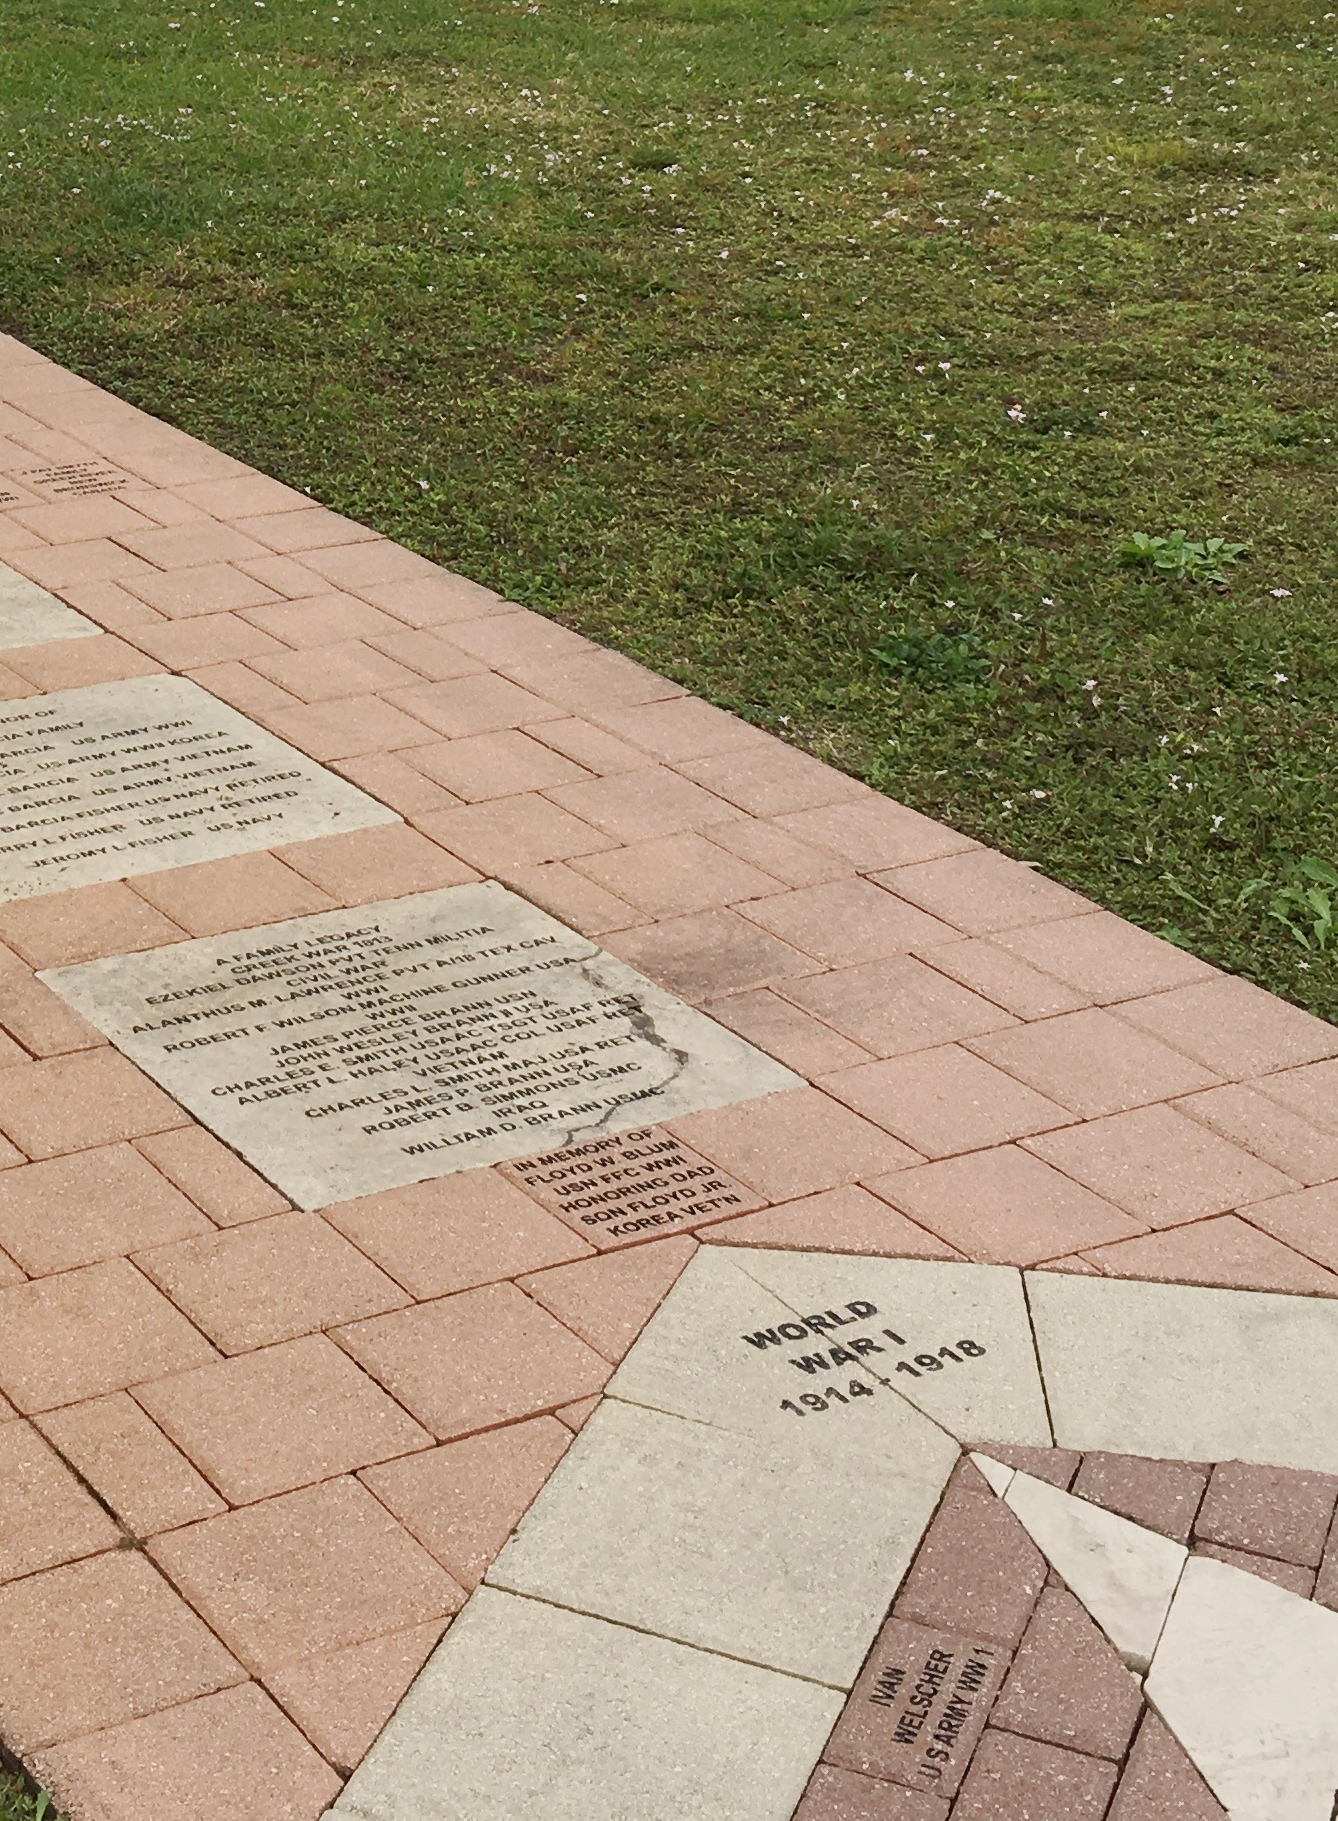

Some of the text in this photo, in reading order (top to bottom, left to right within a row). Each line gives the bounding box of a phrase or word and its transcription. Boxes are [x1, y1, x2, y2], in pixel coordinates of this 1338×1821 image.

[25, 720, 84, 737] FAMILY
[34, 709, 56, 718] OF
[36, 761, 63, 770] US
[67, 750, 117, 765] ARMY
[166, 730, 228, 746] KOREA
[111, 844, 127, 852] L
[127, 830, 196, 848] FISHER
[206, 822, 234, 832] US
[235, 812, 284, 827] NAVY
[144, 926, 495, 1005] EZEKIEL DAWSON PVT TENN MILITIA
[216, 924, 381, 967] A FAMILY LEGACY
[230, 954, 302, 974] CREEK
[300, 944, 351, 960] WAR
[285, 960, 389, 988] CIVIL WAR
[340, 984, 389, 1000] WWI
[162, 1027, 250, 1053] ROBERT
[271, 1004, 357, 1028] WILSON
[357, 984, 450, 1010] MACHINE
[450, 966, 534, 989] GUNNER
[534, 956, 581, 970] USA
[270, 990, 538, 1056] JAMES PIERCE BRANN USN
[364, 1004, 418, 1021] WWII
[275, 999, 559, 1068] JOHN WESLEY BRANN II USA
[411, 1050, 510, 1078] VIETNAM
[361, 1106, 452, 1135] ROBERT
[480, 1077, 581, 1106] SIMMONS
[578, 1062, 642, 1082] USMC
[383, 1092, 454, 1116] JAMES
[473, 1068, 552, 1093] BRANN
[552, 1058, 600, 1074] USA
[491, 1100, 550, 1119] IRAQ
[400, 1086, 666, 1156] WILLIAM D. BRANN USMC
[512, 1128, 652, 1172] IN MEMORY OF
[523, 1162, 594, 1187] FLOYD
[620, 1139, 681, 1161] BLUM
[552, 1178, 599, 1196] USN
[638, 1154, 688, 1173] WWI
[558, 1166, 716, 1214] HONORING DAD
[580, 1180, 733, 1226] SON FLOYD JR.
[606, 1193, 742, 1238] KOREA VET'N
[742, 1300, 878, 1351] WORLD
[789, 1329, 907, 1376] WAR I
[779, 1380, 873, 1419] 1914
[895, 1340, 987, 1380] 1918
[869, 1666, 906, 1707] IVAN
[891, 1650, 954, 1744] WELSCHER
[933, 1693, 972, 1748] ARMY
[956, 1659, 988, 1692] WW
[972, 1648, 994, 1656] 1
